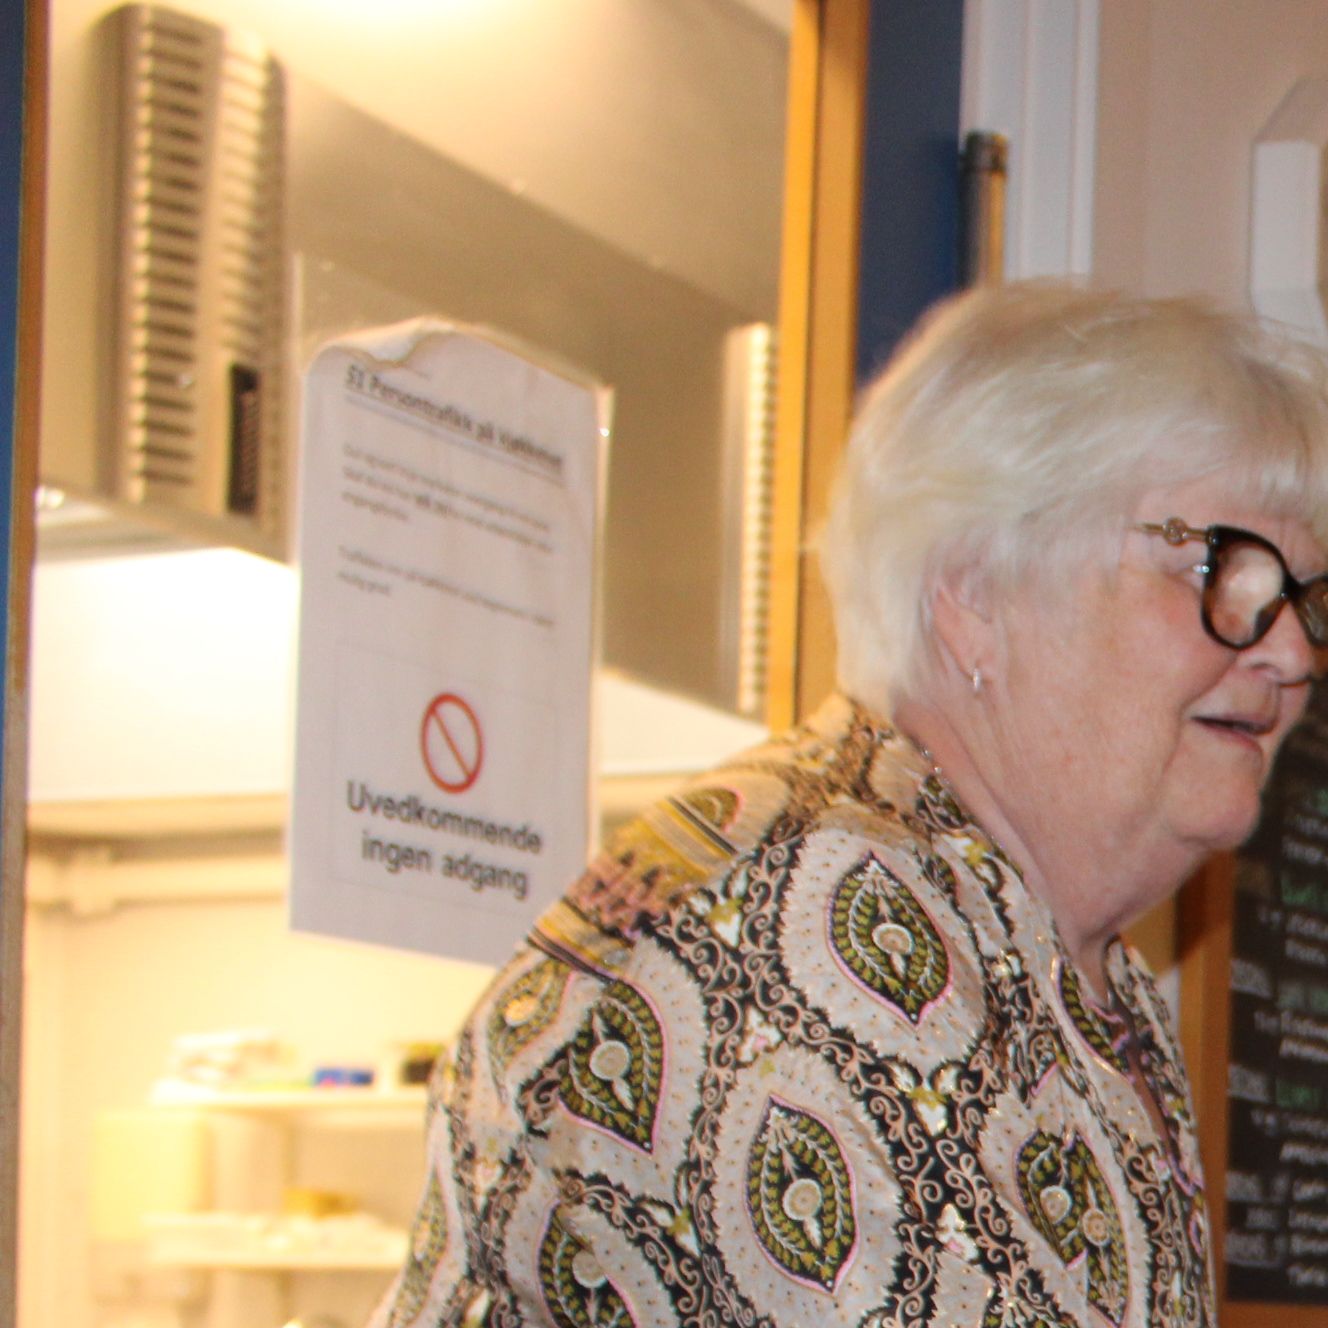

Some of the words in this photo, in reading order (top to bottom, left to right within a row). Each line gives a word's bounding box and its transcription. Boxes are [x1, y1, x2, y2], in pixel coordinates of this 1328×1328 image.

[346, 780, 544, 854] Uvedkommende
[361, 829, 433, 875] ingen
[441, 852, 530, 901] adgang
